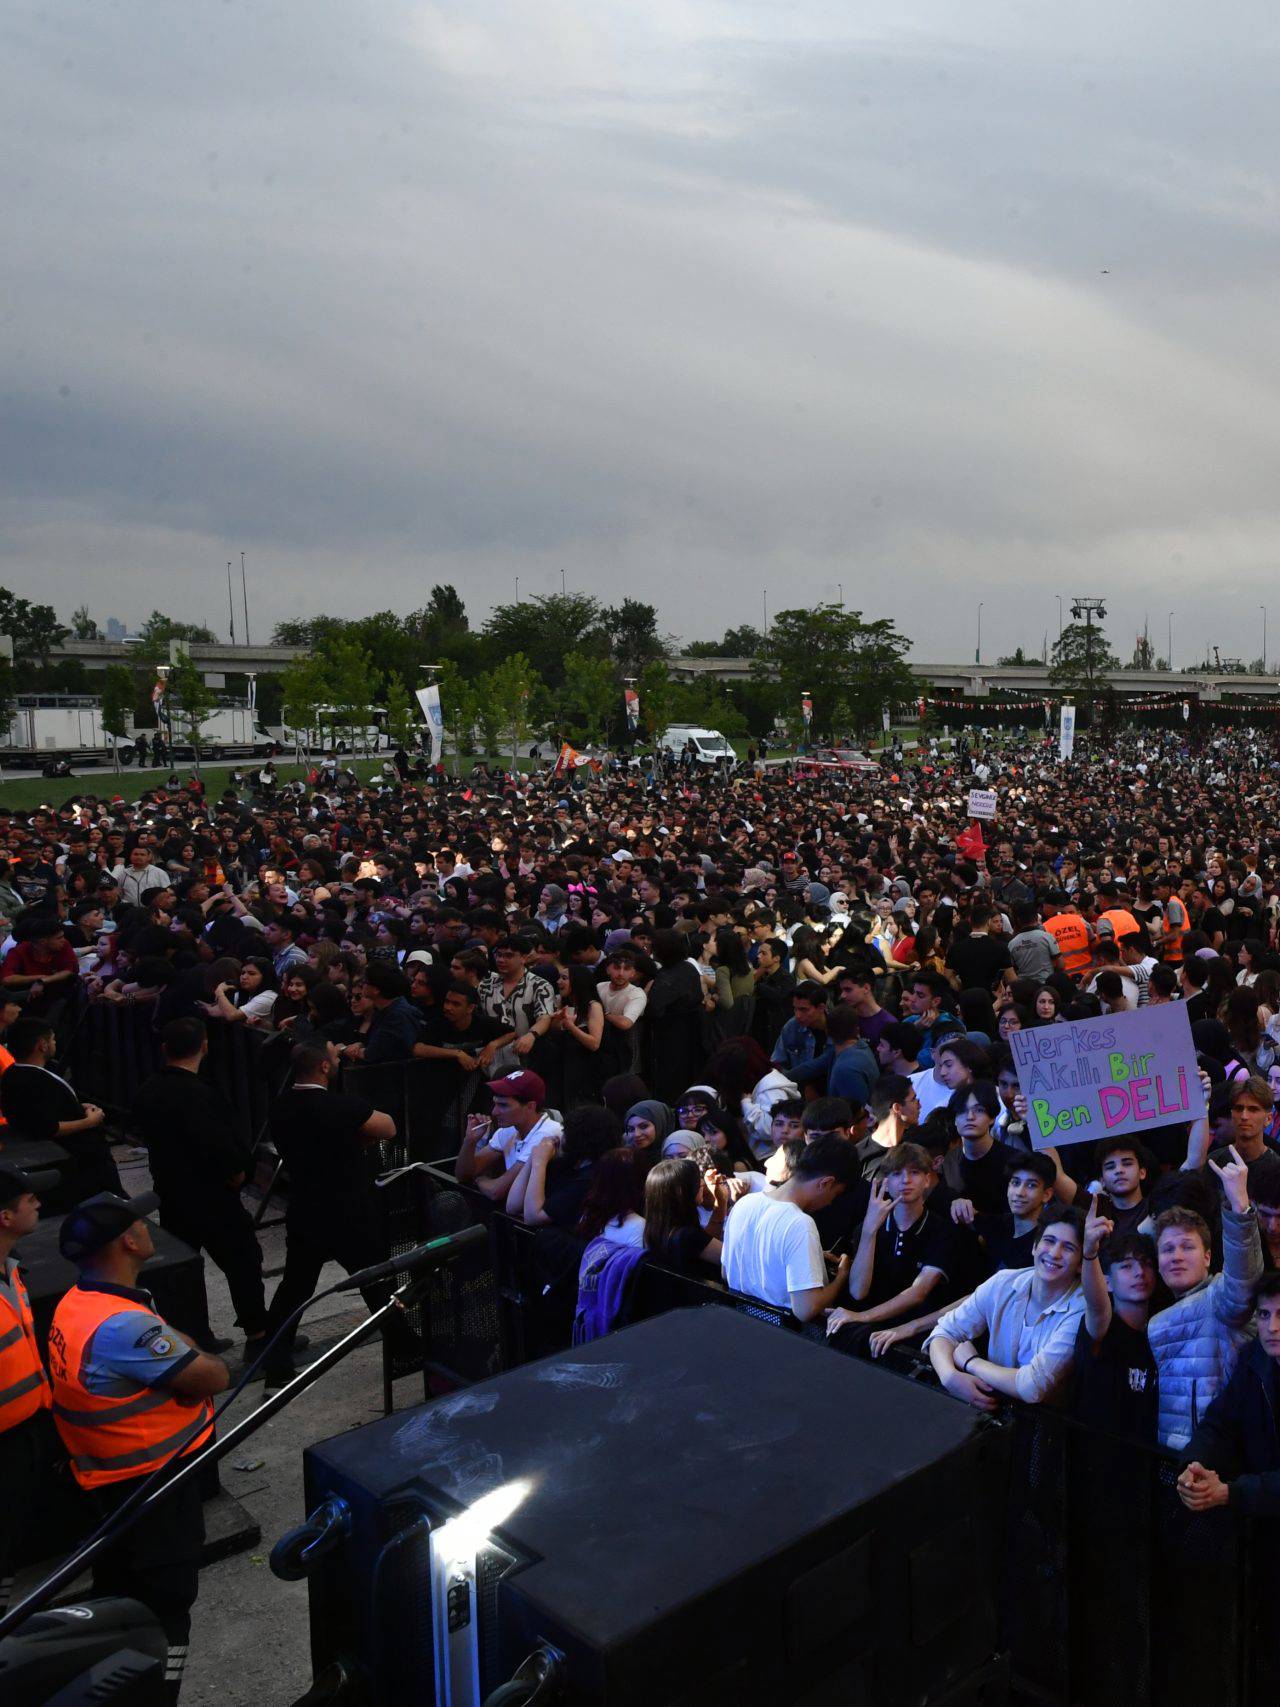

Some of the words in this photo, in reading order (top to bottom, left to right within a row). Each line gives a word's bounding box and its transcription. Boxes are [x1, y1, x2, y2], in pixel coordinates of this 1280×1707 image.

[1055, 926, 1080, 936] ÖZEL
[1013, 1027, 1116, 1065] Herkes
[1108, 1052, 1155, 1082] Bir
[1032, 1099, 1092, 1137] Ben
[1098, 1066, 1189, 1128] DELİ
